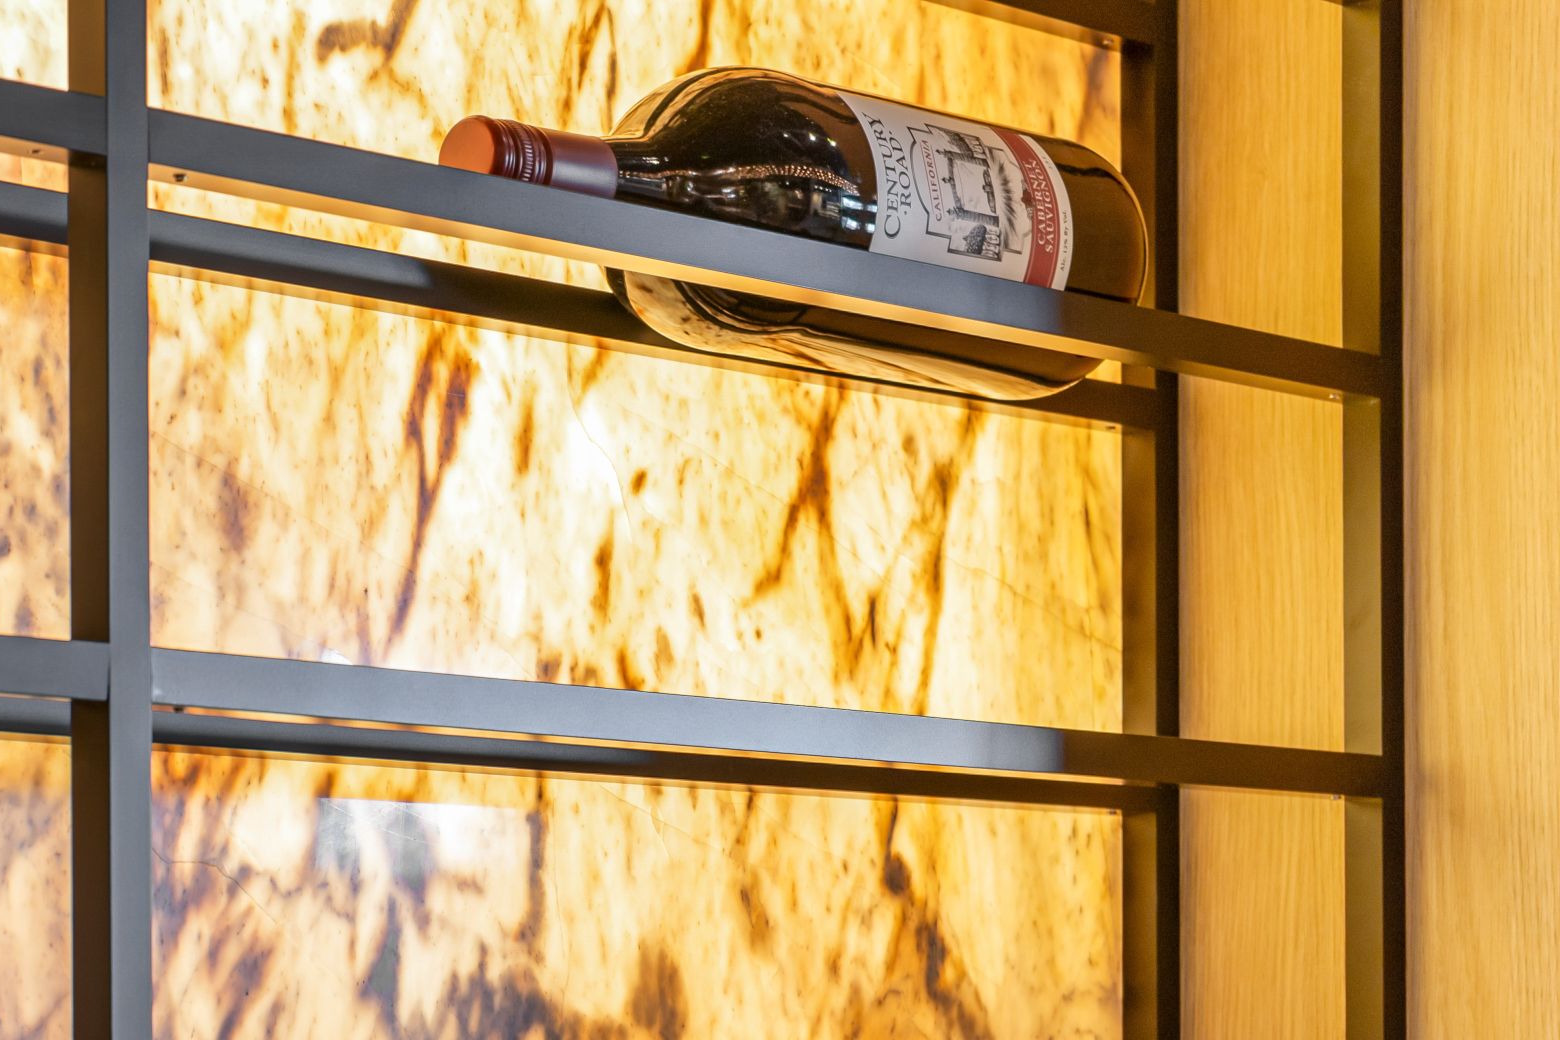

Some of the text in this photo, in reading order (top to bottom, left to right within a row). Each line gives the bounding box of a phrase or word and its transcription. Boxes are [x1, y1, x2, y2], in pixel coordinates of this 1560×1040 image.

[862, 111, 901, 239] CENTURY
[922, 139, 942, 222] CALIFORNIA
[1023, 158, 1046, 245] CABERNET
[1030, 158, 1054, 253] SAUVIGNON
